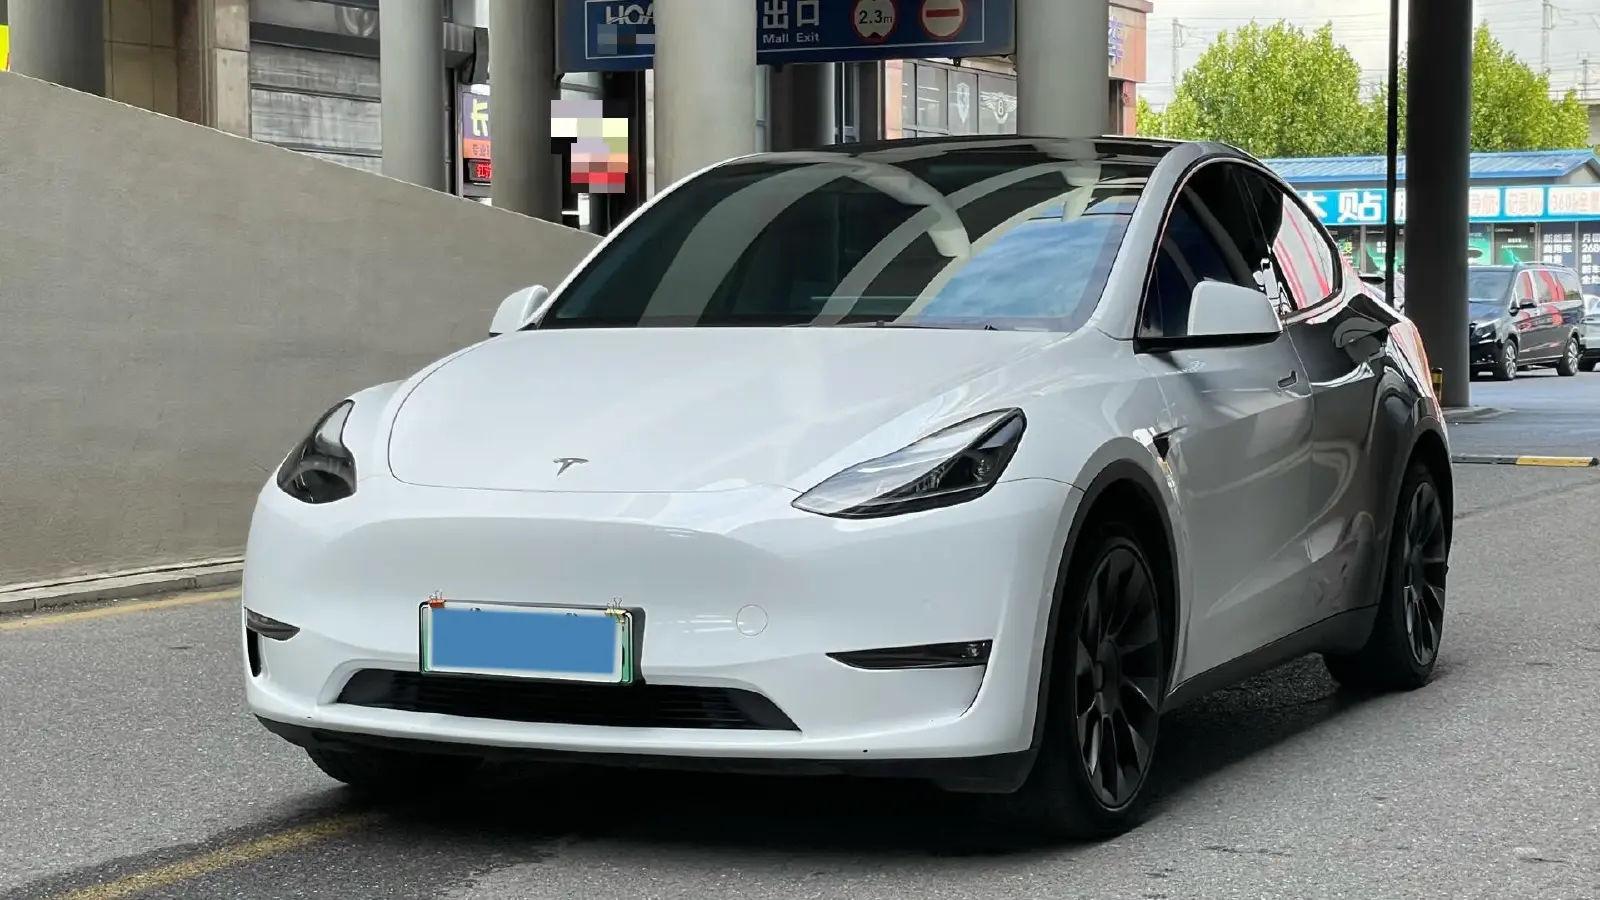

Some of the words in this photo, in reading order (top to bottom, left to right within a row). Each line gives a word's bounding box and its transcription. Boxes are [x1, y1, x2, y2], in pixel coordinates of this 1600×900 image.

[763, 0, 820, 29] 出口
[859, 10, 893, 25] 2.3m
[763, 33, 789, 43] Mall
[796, 32, 819, 43] Exit
